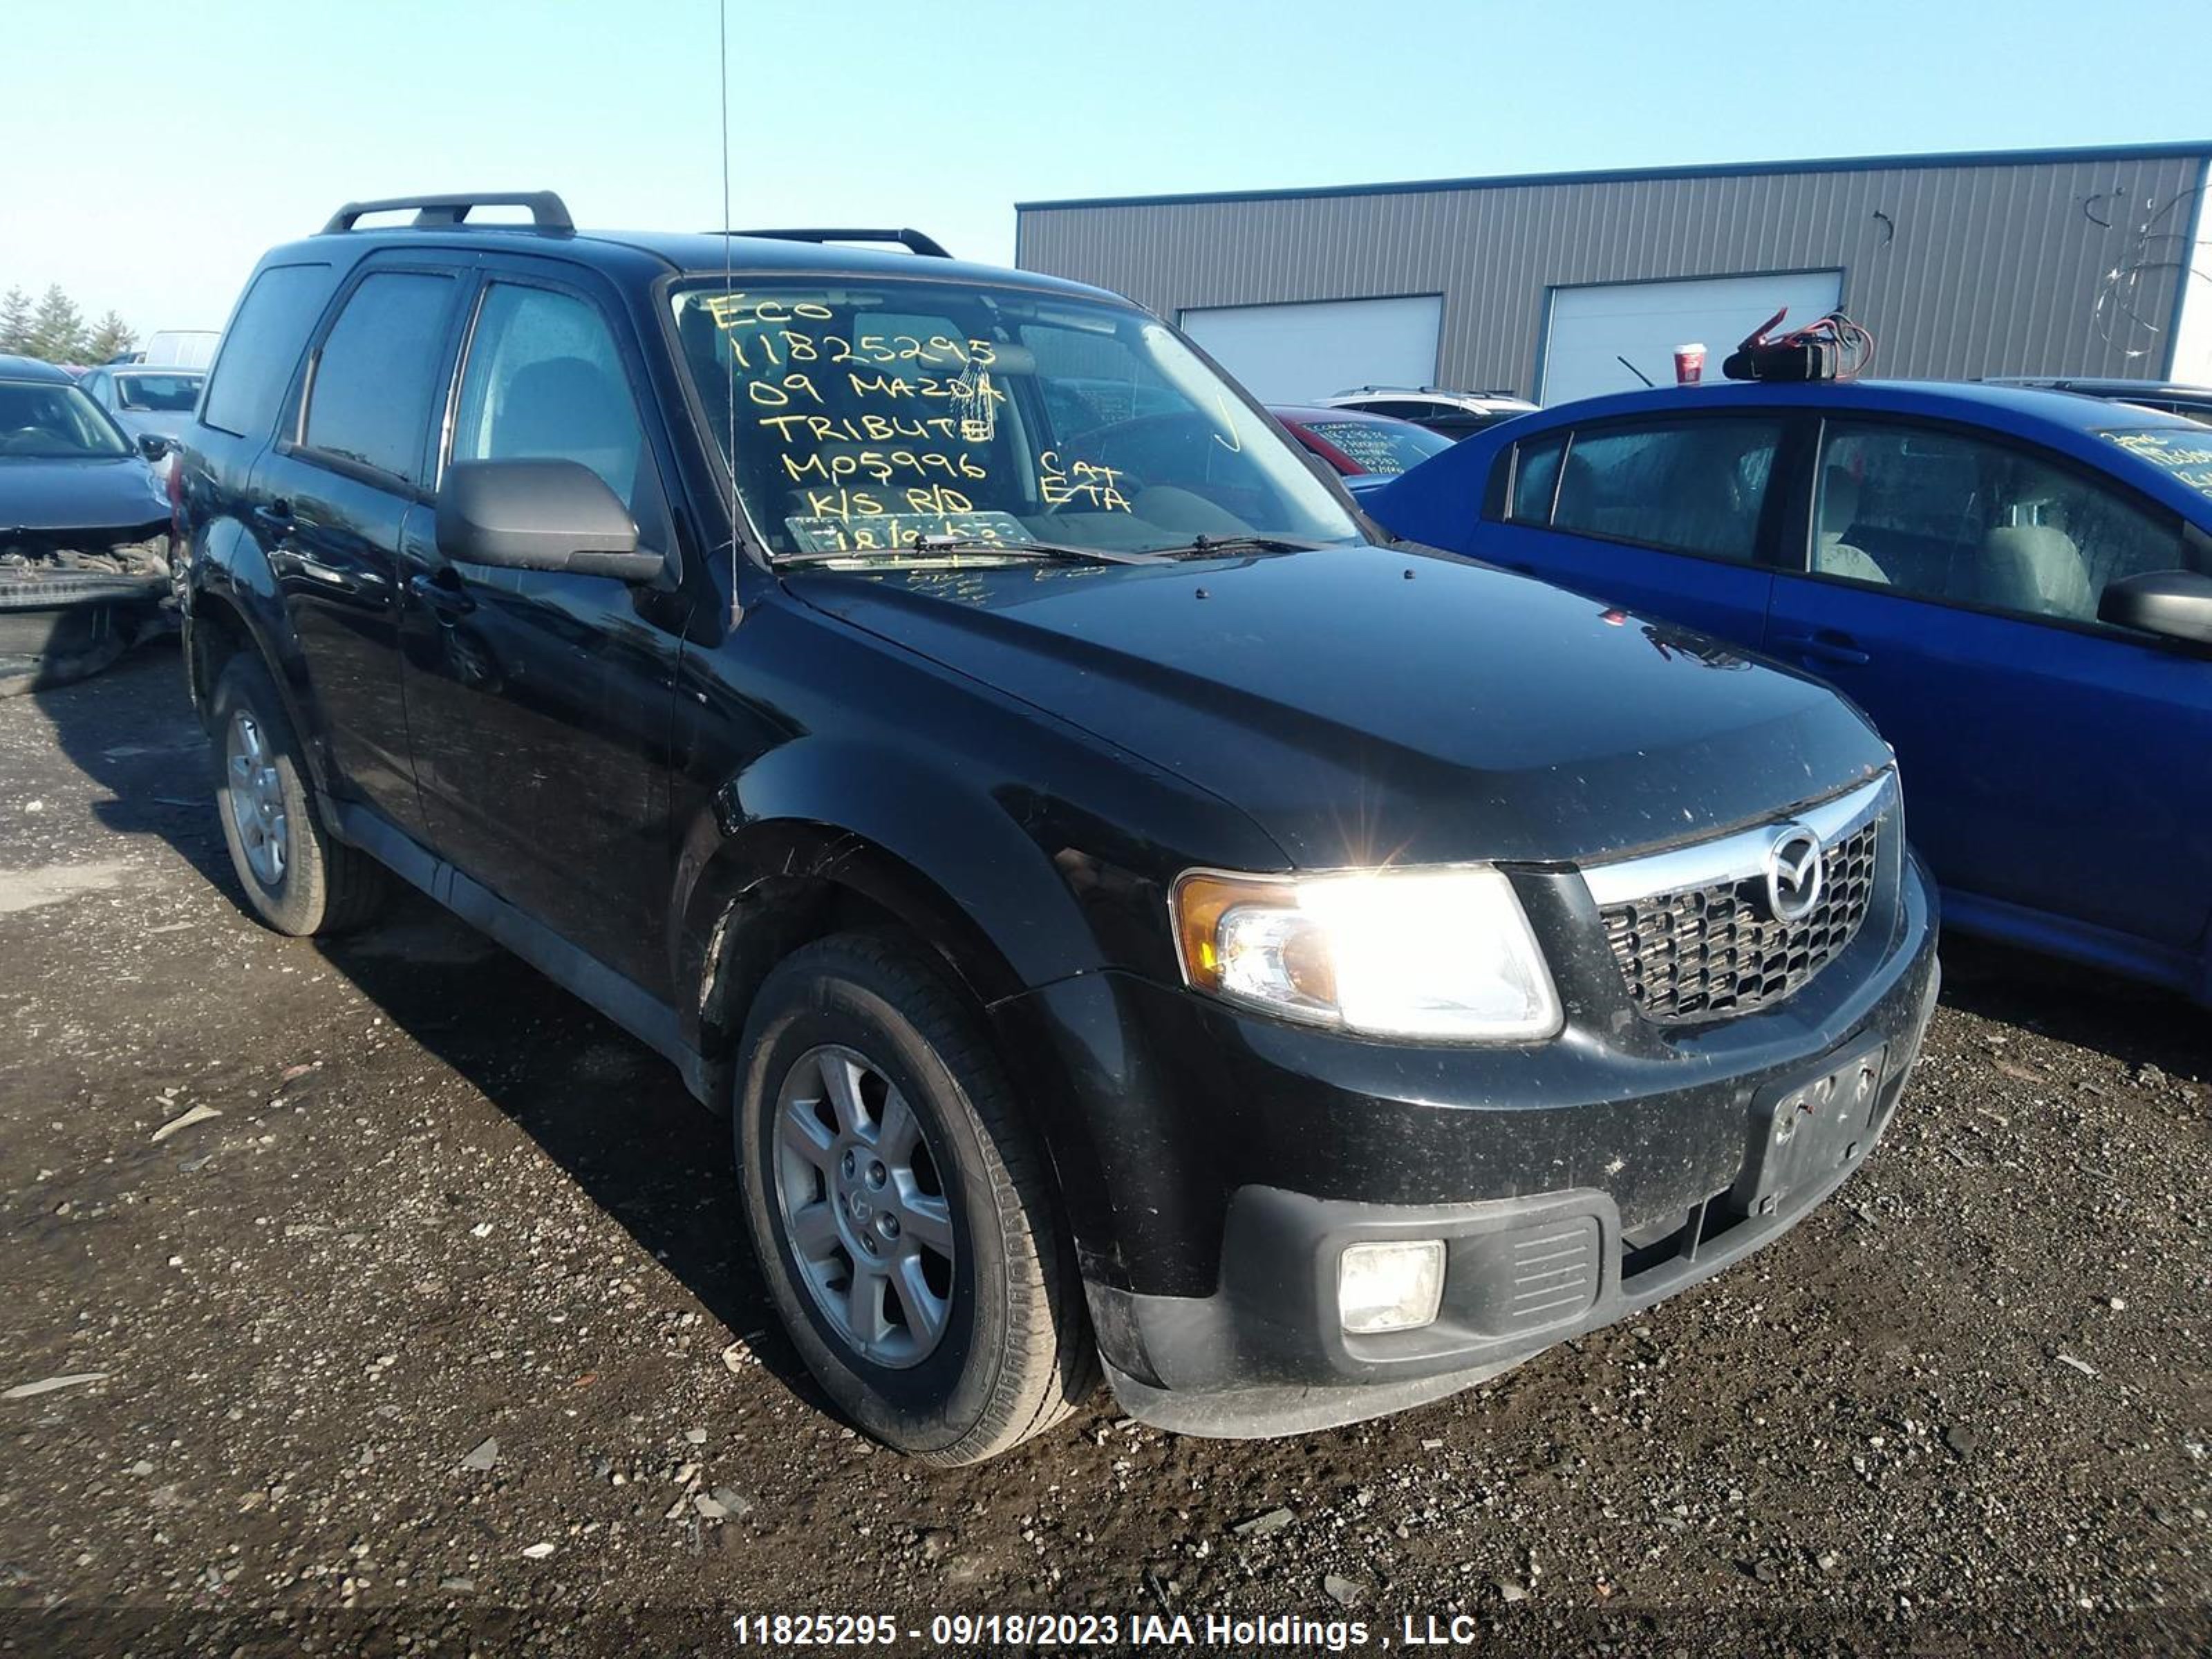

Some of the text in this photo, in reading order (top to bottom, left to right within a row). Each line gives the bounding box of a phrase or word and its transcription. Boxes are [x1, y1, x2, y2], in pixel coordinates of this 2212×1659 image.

[730, 330, 997, 369] 11825295
[749, 373, 1007, 406] 09 MAZDA
[759, 415, 993, 442] TRIBUTE
